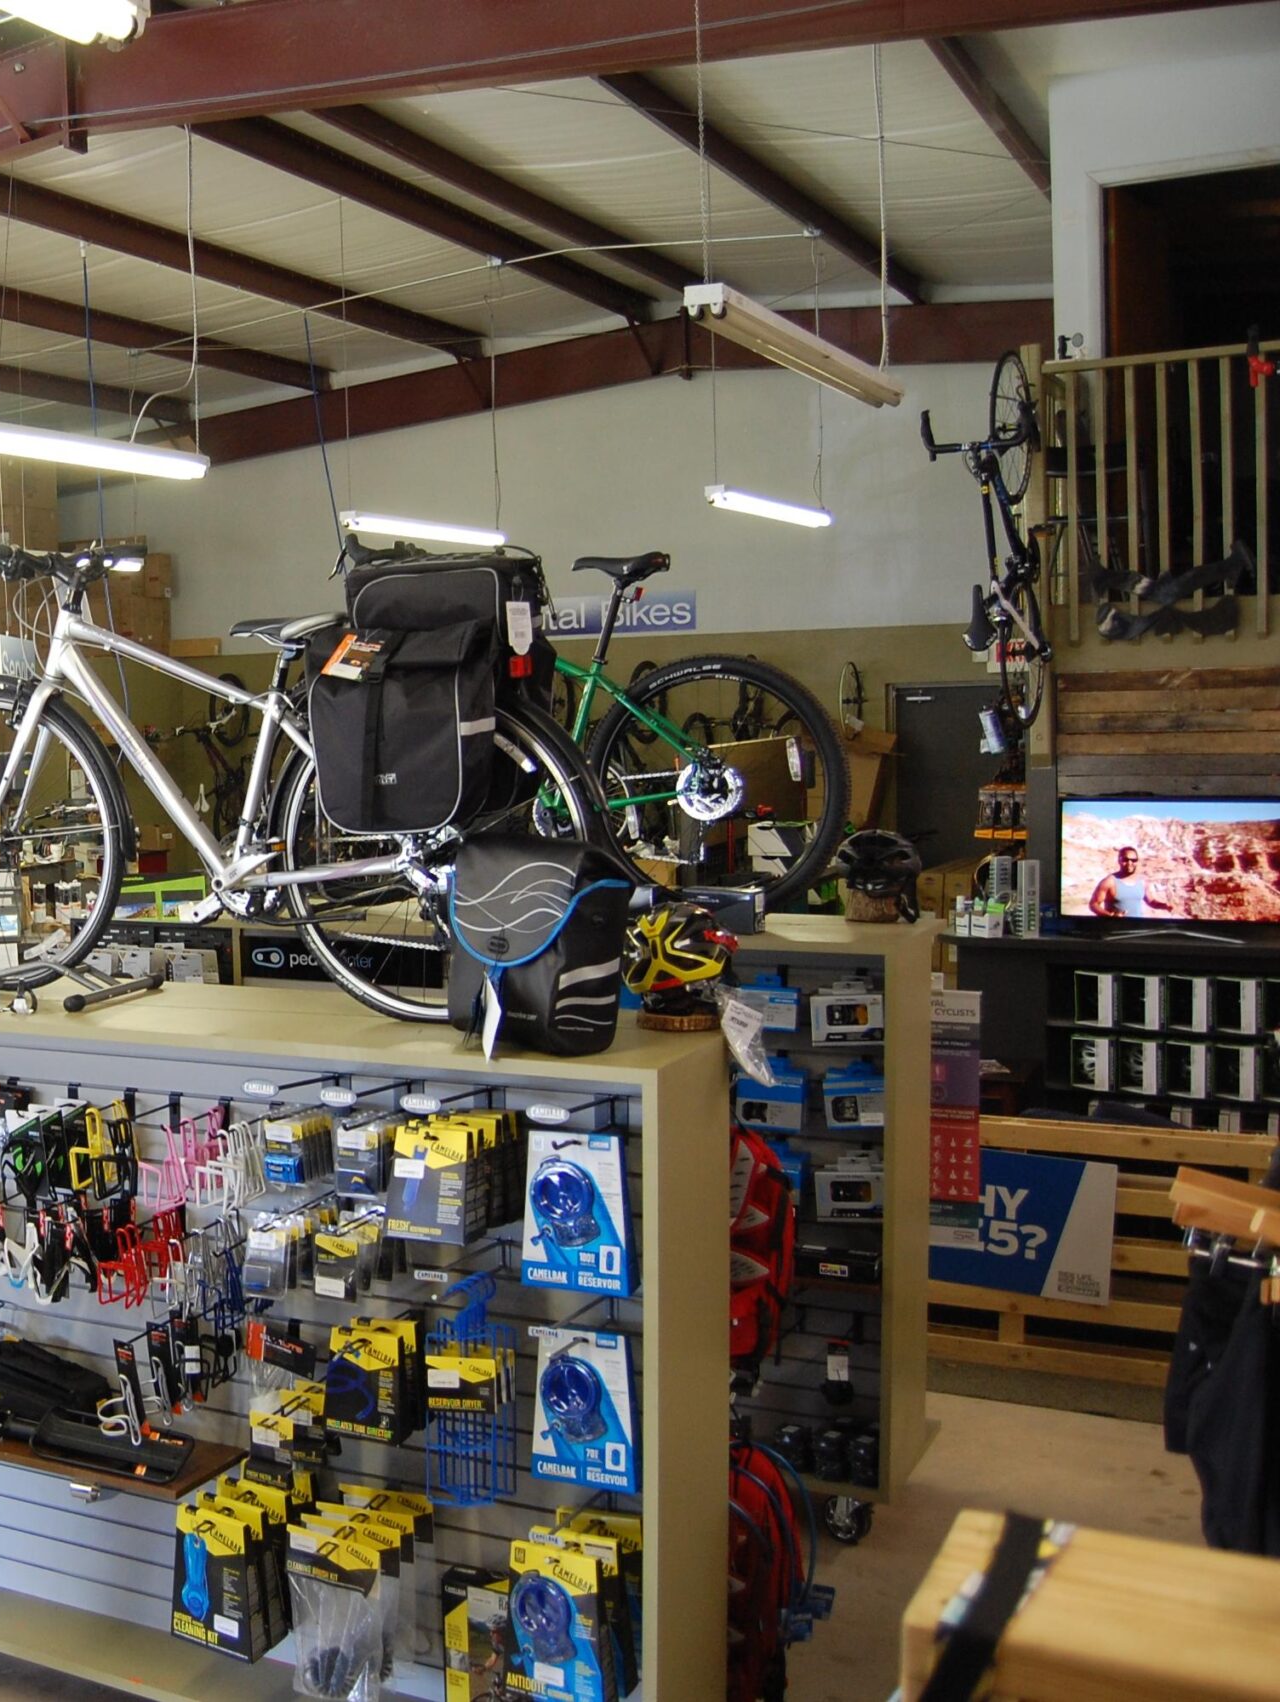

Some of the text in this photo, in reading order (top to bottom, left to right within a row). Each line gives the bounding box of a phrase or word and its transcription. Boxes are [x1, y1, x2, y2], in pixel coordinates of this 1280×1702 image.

[600, 597, 692, 631] Bikes
[934, 1008, 976, 1017] CYCLISTS
[431, 1141, 465, 1161] CAMELBAK
[979, 1184, 1029, 1221] HY
[527, 1266, 568, 1285] CAMELBAK
[577, 1274, 621, 1291] RESERVOIR
[364, 1344, 396, 1366] CAMELBAK
[428, 1397, 461, 1409] RESERVOIR
[537, 1460, 577, 1479] CAMELBAK
[586, 1470, 628, 1487] RESERVOIR
[377, 1514, 408, 1533] CAMELBAK
[362, 1527, 394, 1546] CAMELBAK
[346, 1544, 374, 1568] CAMELBAK
[552, 1564, 593, 1594] CAMELBAK
[173, 1618, 206, 1640] CLEANING
[207, 1627, 219, 1645] KIT
[506, 1671, 547, 1694] ANTIDOTE
